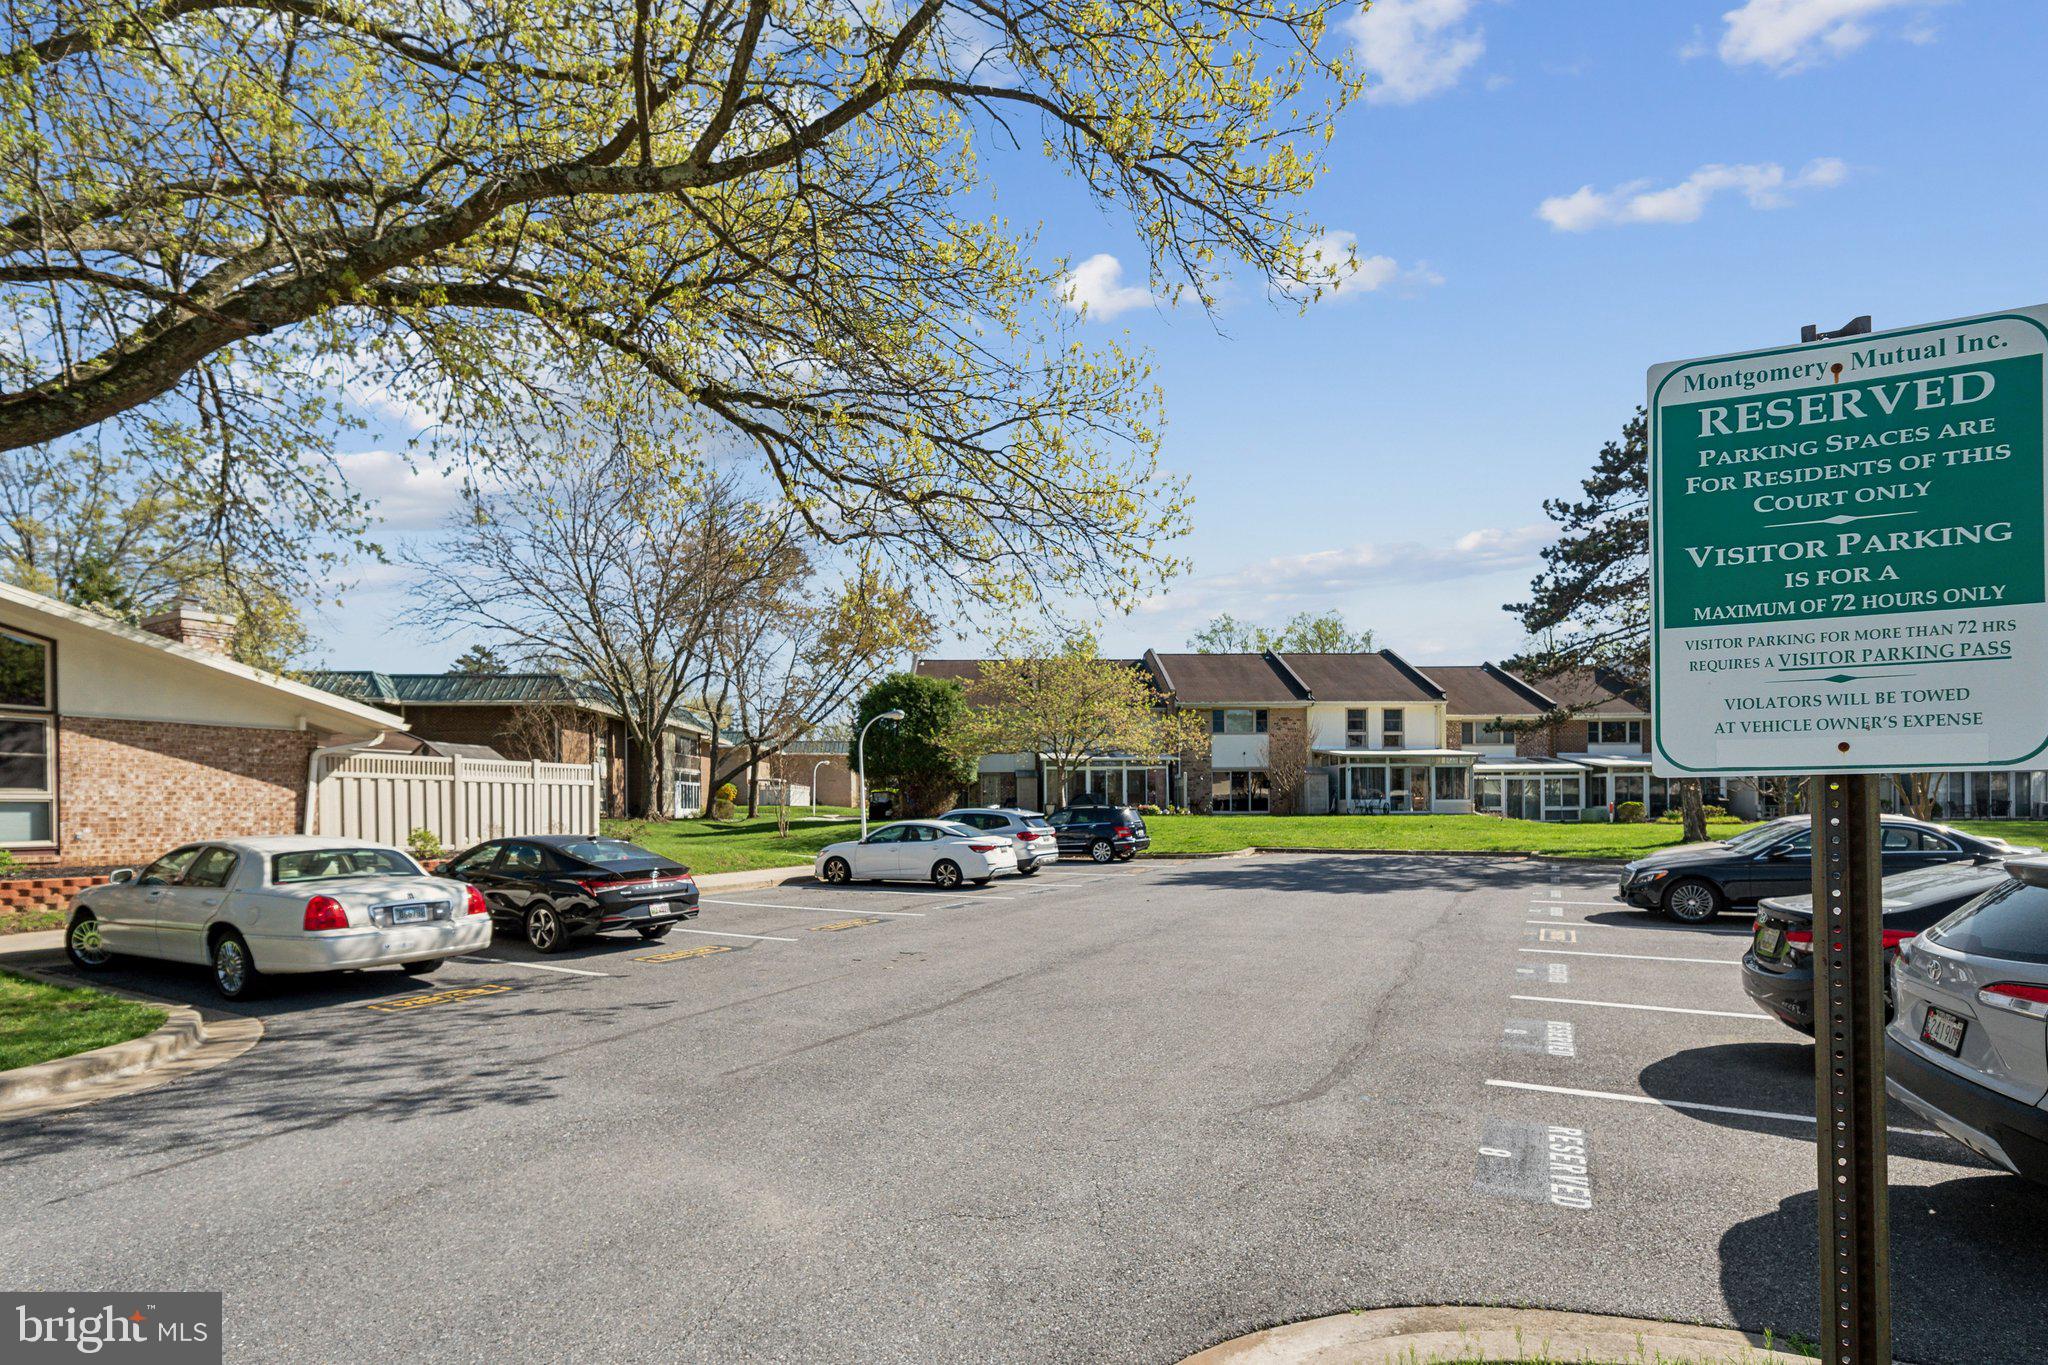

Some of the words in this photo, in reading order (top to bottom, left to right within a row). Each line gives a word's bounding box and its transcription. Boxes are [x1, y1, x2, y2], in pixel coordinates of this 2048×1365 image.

[1683, 358, 1829, 394] Montgomery
[1851, 338, 1946, 371] Mutual
[1957, 331, 2008, 354] Inc.
[1696, 370, 1996, 439] RESERVED
[1699, 441, 1818, 467] PARKING
[1825, 426, 1930, 452] SPACES
[1937, 417, 1995, 439] ARE
[1685, 476, 1737, 495] FOR
[1743, 459, 1892, 489] RESIDENTS
[1899, 454, 1937, 469] OF
[1943, 444, 2012, 465] THIS
[1754, 491, 1848, 513] COURT
[1855, 480, 1931, 502] ONLY
[1685, 540, 1826, 569] VISITOR
[1836, 522, 2013, 555] PARKING
[1784, 572, 1810, 589] IS
[1818, 568, 1872, 585] FOR
[1878, 564, 1900, 581] A
[1693, 601, 1795, 621] MAXIMUM
[1800, 598, 1827, 614] OF
[1831, 594, 1856, 611] 72
[1861, 590, 1937, 609] HOURS
[1943, 584, 2007, 603] ONLY
[1685, 637, 1743, 651] VISITOR
[1747, 632, 1815, 647] PARKING
[1820, 630, 1850, 643] FOR
[1854, 626, 1902, 641] MORE
[1906, 623, 1954, 638] THAN
[1958, 621, 1977, 635] 72
[1982, 619, 2017, 632] HRS
[1689, 657, 1760, 674] REQUIRES
[1764, 657, 1775, 669] A
[1778, 650, 1857, 667] VISITOR
[1862, 644, 1955, 663] PARKING
[1960, 640, 2012, 657] PASS
[1724, 694, 1822, 710] VIOLATORS
[1826, 692, 1871, 706] WILL
[1875, 691, 1897, 704] BE
[1901, 687, 1970, 703] TOWED
[1714, 721, 1737, 734] AT
[1741, 719, 1812, 733] VEHICLE
[1816, 715, 1898, 731] OWNER'S
[1903, 712, 1983, 728] EXPENSE
[1548, 1126, 1592, 1209] RESERVED
